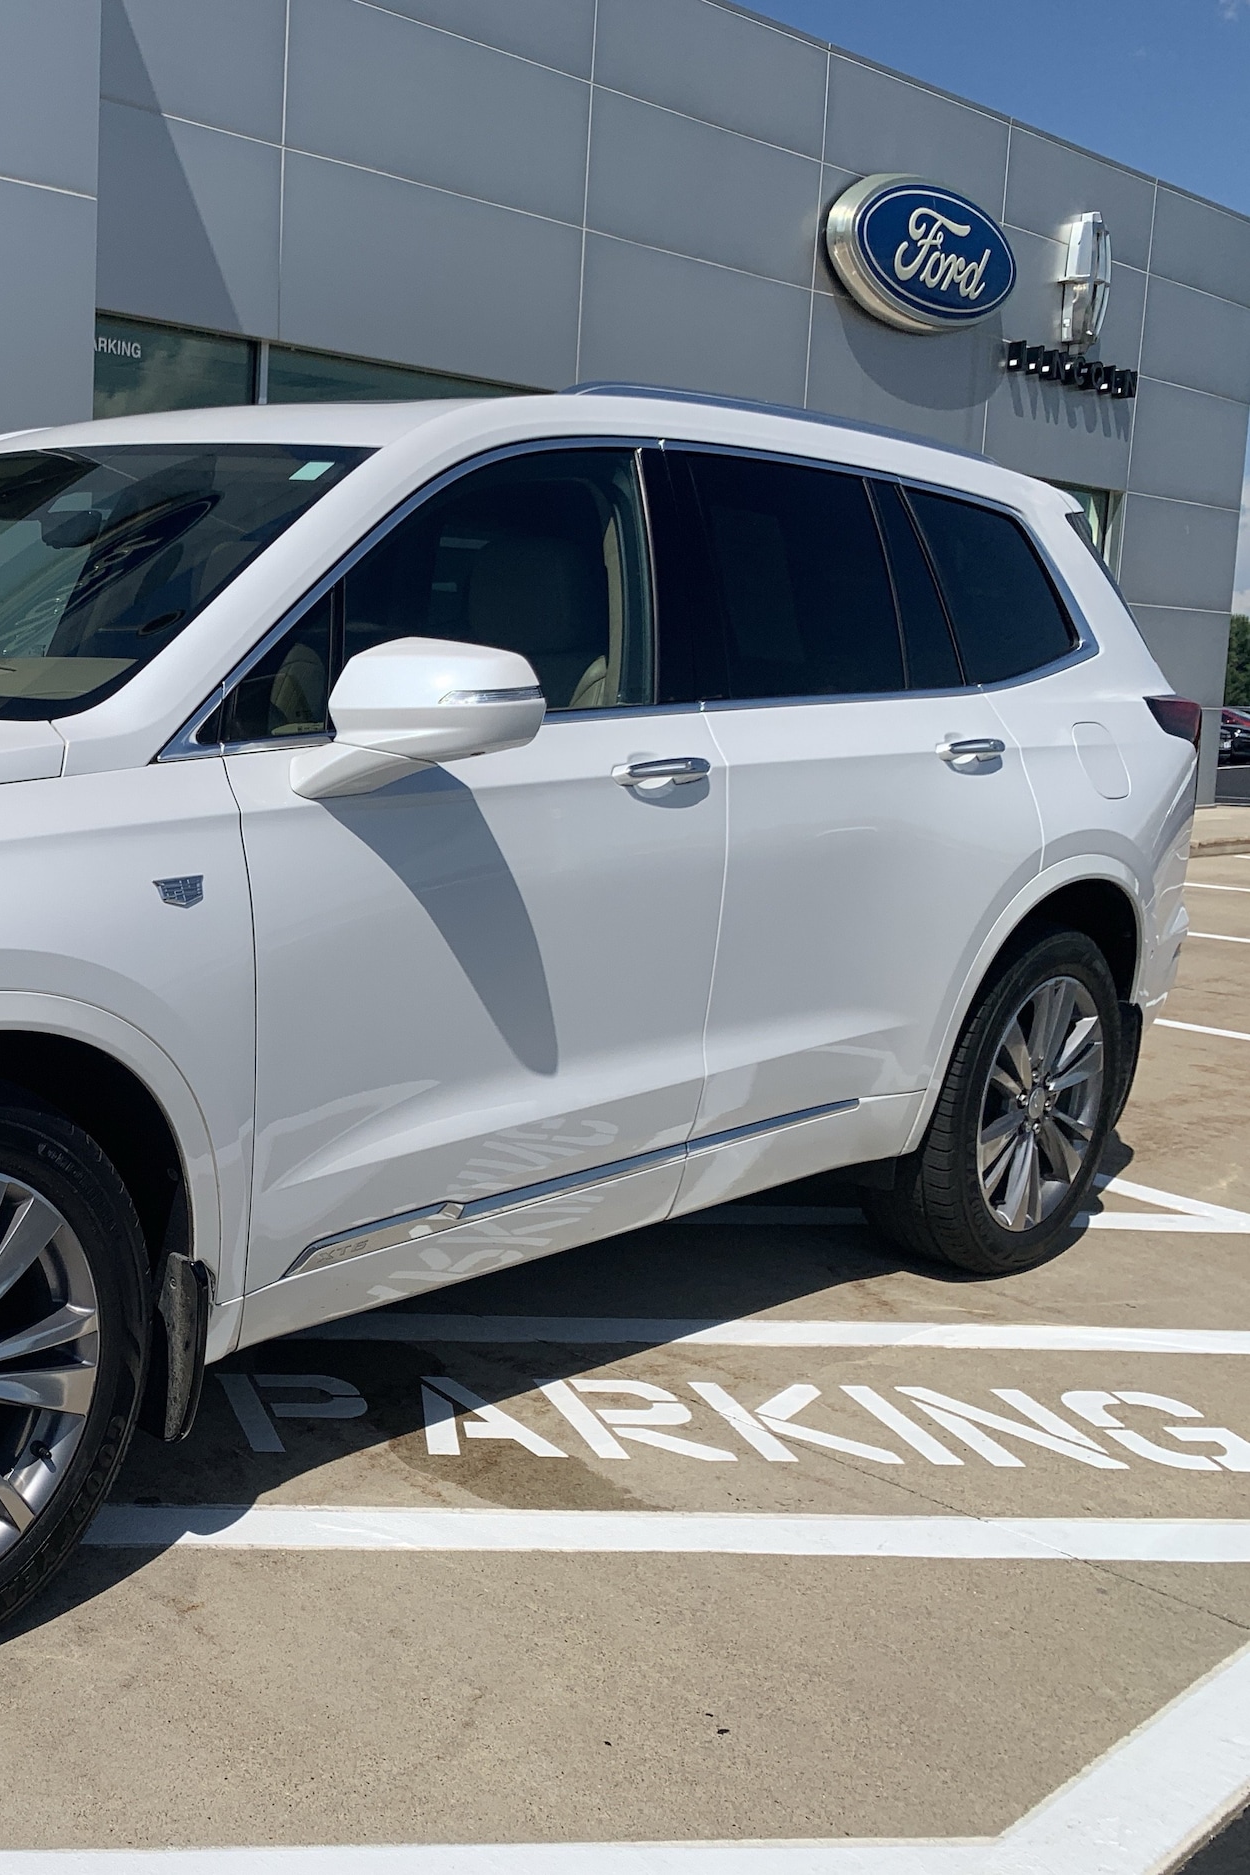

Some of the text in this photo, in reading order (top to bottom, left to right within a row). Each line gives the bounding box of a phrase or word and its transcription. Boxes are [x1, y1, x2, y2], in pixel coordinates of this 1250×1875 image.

[894, 207, 991, 300] Ford
[317, 1240, 369, 1263] XT6
[214, 1373, 1250, 1472] PARKING
